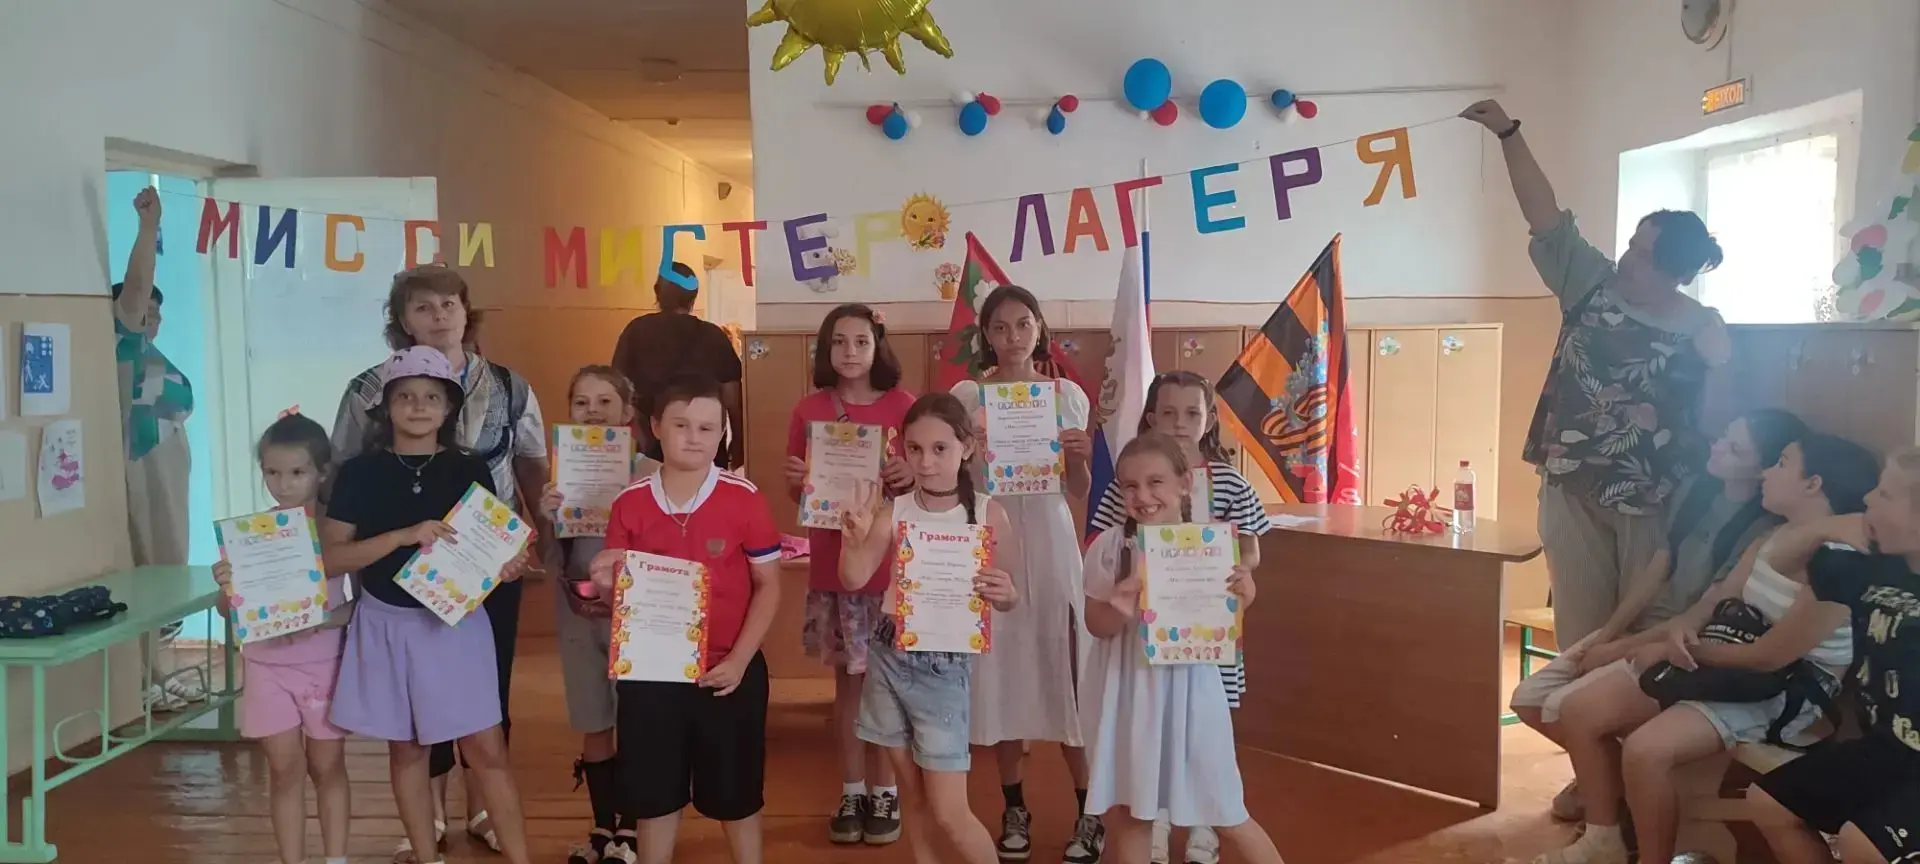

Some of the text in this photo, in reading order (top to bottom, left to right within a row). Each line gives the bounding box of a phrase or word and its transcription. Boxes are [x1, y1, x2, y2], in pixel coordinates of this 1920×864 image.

[195, 126, 1417, 290] МИСС И МИСТЕР ЛАГЕРЯ
[919, 531, 970, 543] Грамота
[638, 561, 690, 576] Грамота
